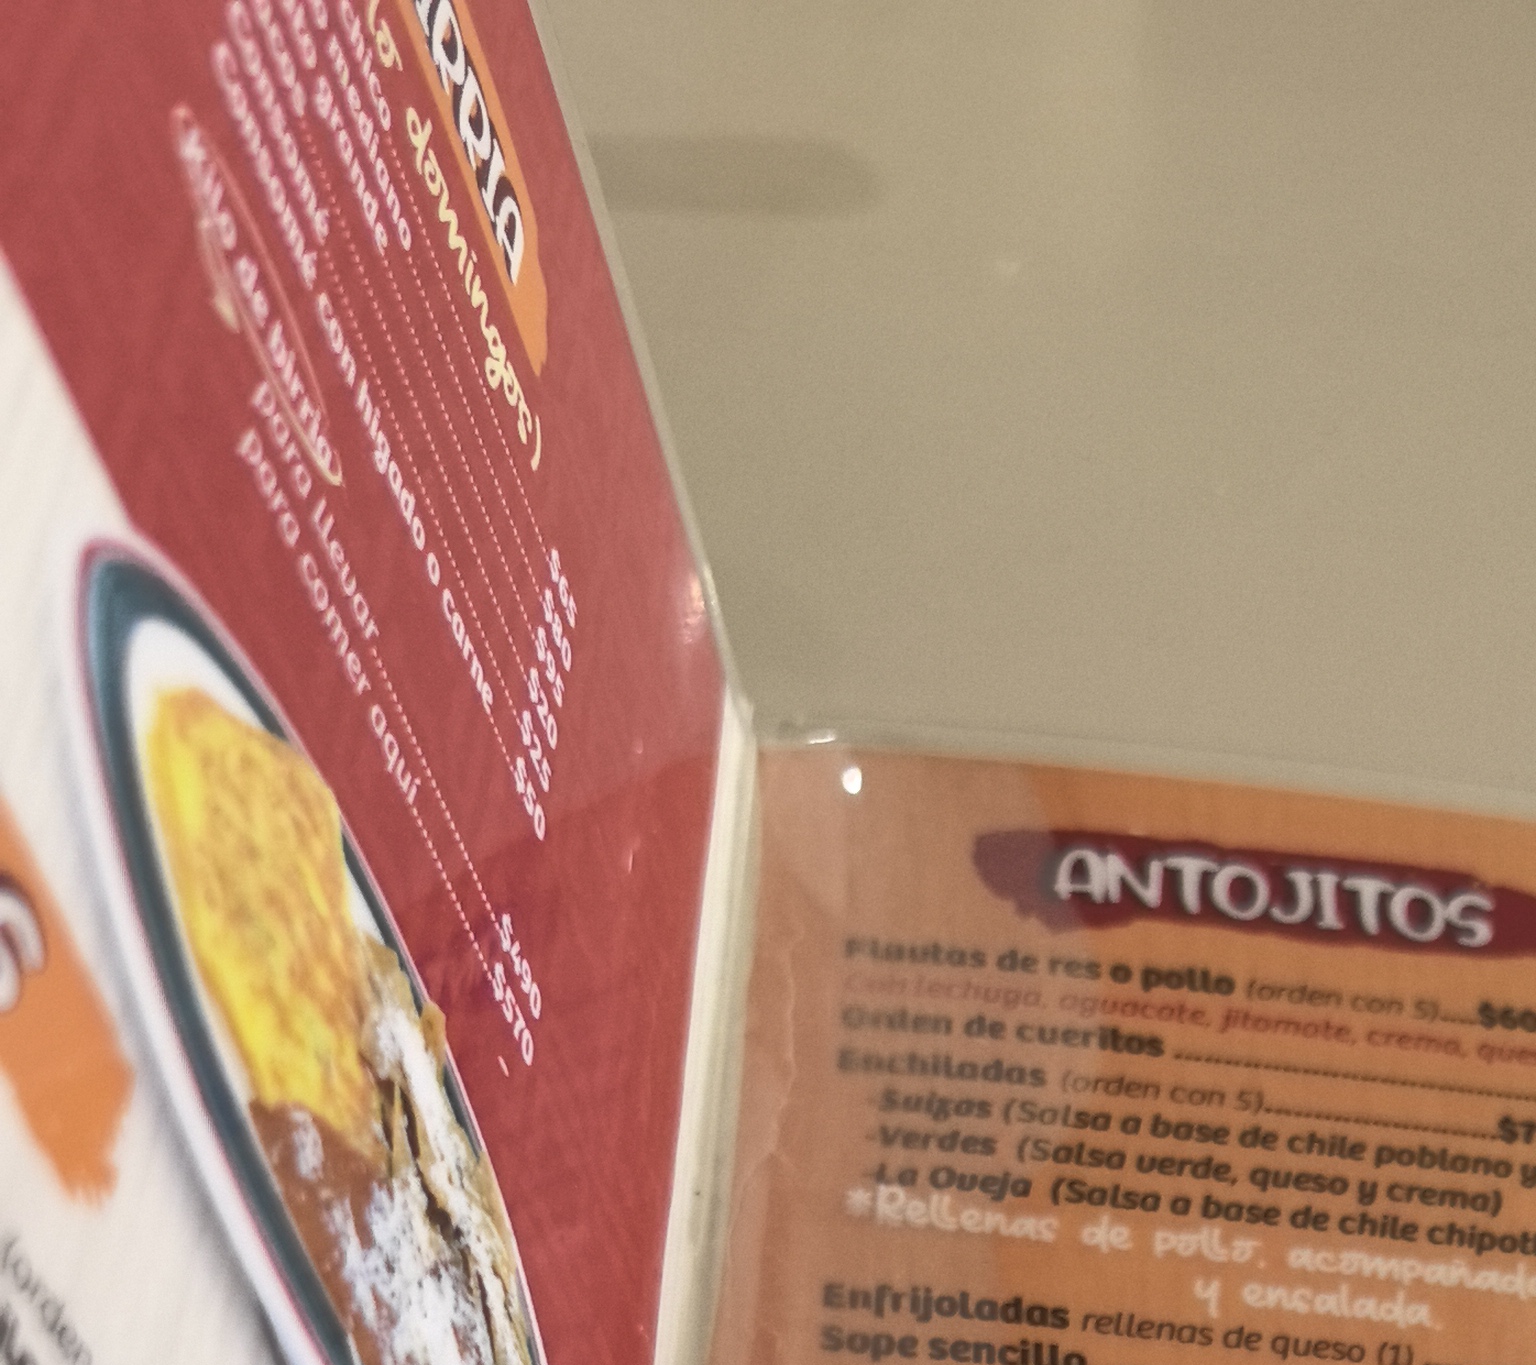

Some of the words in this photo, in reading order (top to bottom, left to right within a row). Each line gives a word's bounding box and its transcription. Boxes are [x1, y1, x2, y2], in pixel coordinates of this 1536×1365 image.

[550, 548, 577, 627] $65
[442, 588, 494, 708] carne
[514, 757, 545, 840] $50
[529, 667, 558, 749] $20
[522, 711, 551, 792] $25
[299, 552, 371, 695] comer
[492, 962, 534, 1066] $570
[1053, 848, 1495, 949] ANTOJITOS
[500, 913, 542, 1020] $490
[1017, 1136, 1127, 1171] (Salsa
[1136, 1152, 1238, 1187] verde,
[1249, 1166, 1349, 1196] queso
[1357, 1179, 1379, 1205] y
[1386, 1181, 1504, 1217] crema)
[1286, 1132, 1366, 1163] chile
[1374, 1142, 1513, 1179] poblano
[819, 1324, 919, 1363] Sope
[821, 1282, 1070, 1331] Enfrijoladas
[1081, 1311, 1213, 1347] rellenas
[1223, 1327, 1262, 1352] de
[1270, 1334, 1366, 1364] queso
